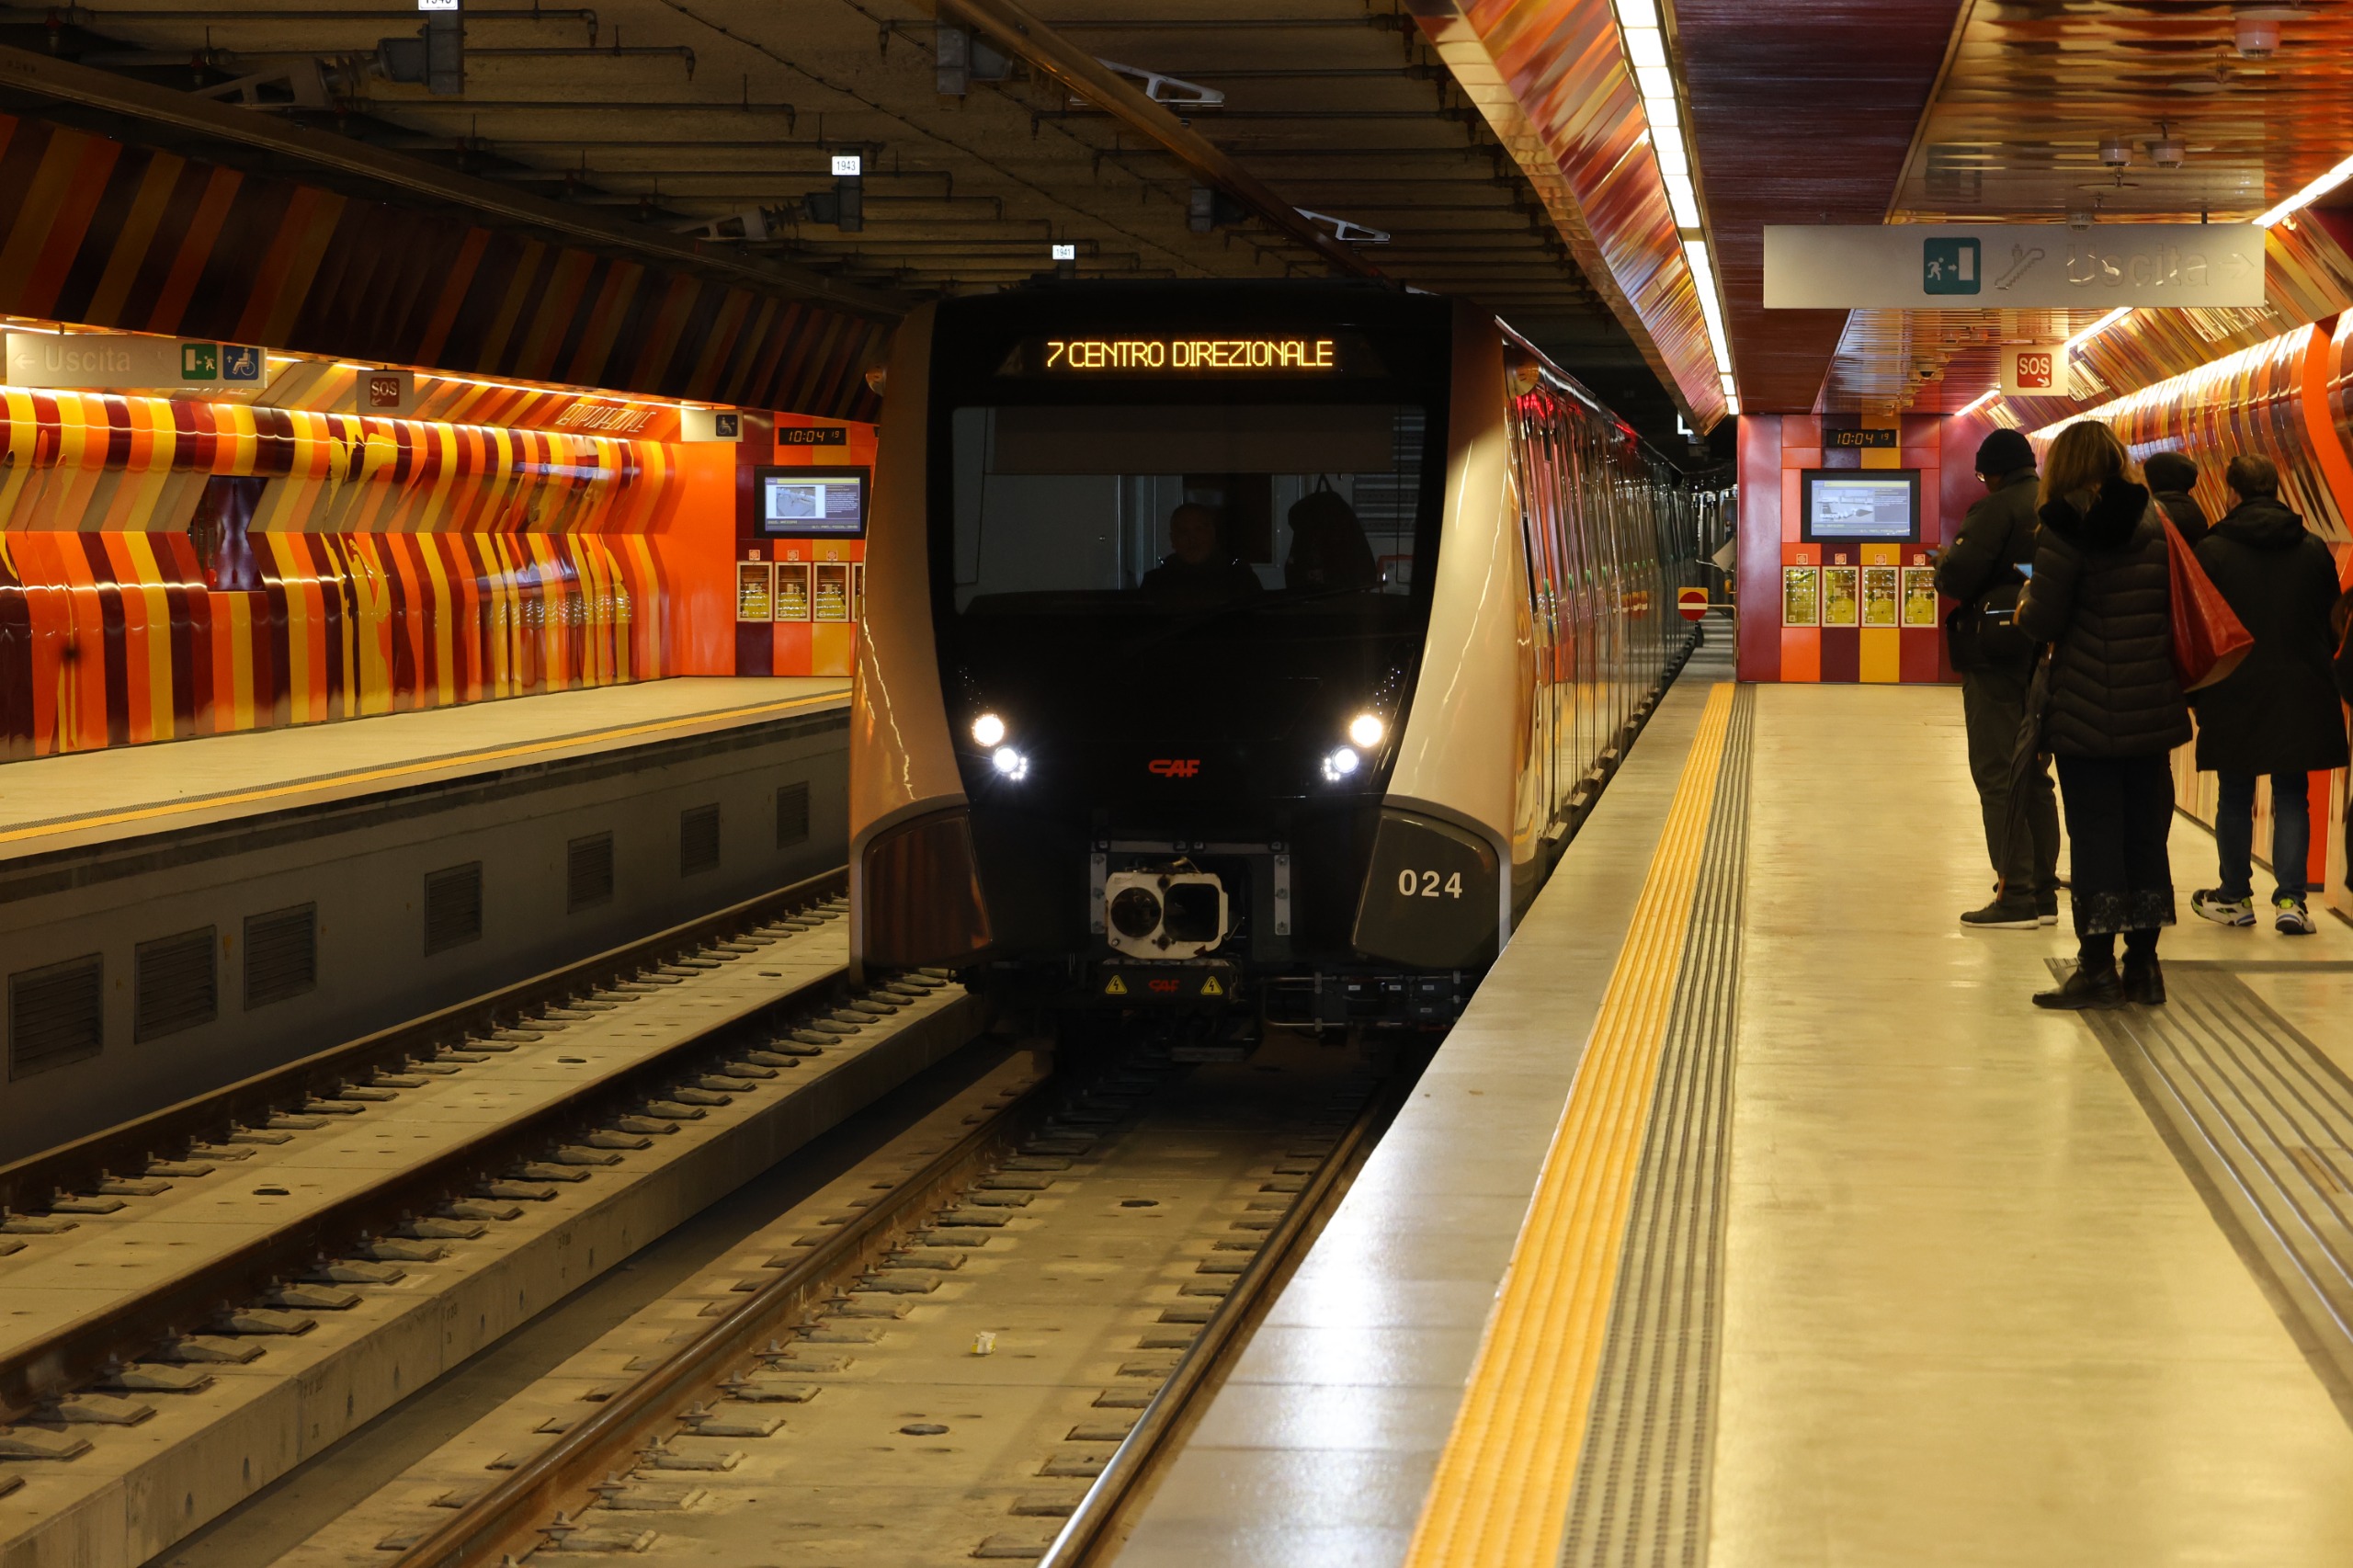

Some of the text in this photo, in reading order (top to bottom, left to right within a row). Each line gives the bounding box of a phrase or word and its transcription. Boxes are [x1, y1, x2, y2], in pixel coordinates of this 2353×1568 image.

[836, 160, 856, 171] 1943
[1056, 248, 1071, 256] 1941
[2066, 243, 2209, 288] Uscita
[44, 344, 131, 372] Uscita
[1047, 341, 1333, 367] 7 CENTRO DIREZIONALE
[2018, 357, 2050, 375] SOS
[371, 381, 397, 396] SOS
[789, 430, 825, 443] 10:04
[1837, 432, 1874, 445] 10:04
[1148, 759, 1200, 778] CAF
[1398, 869, 1463, 899] 024
[1149, 979, 1180, 993] CAF
